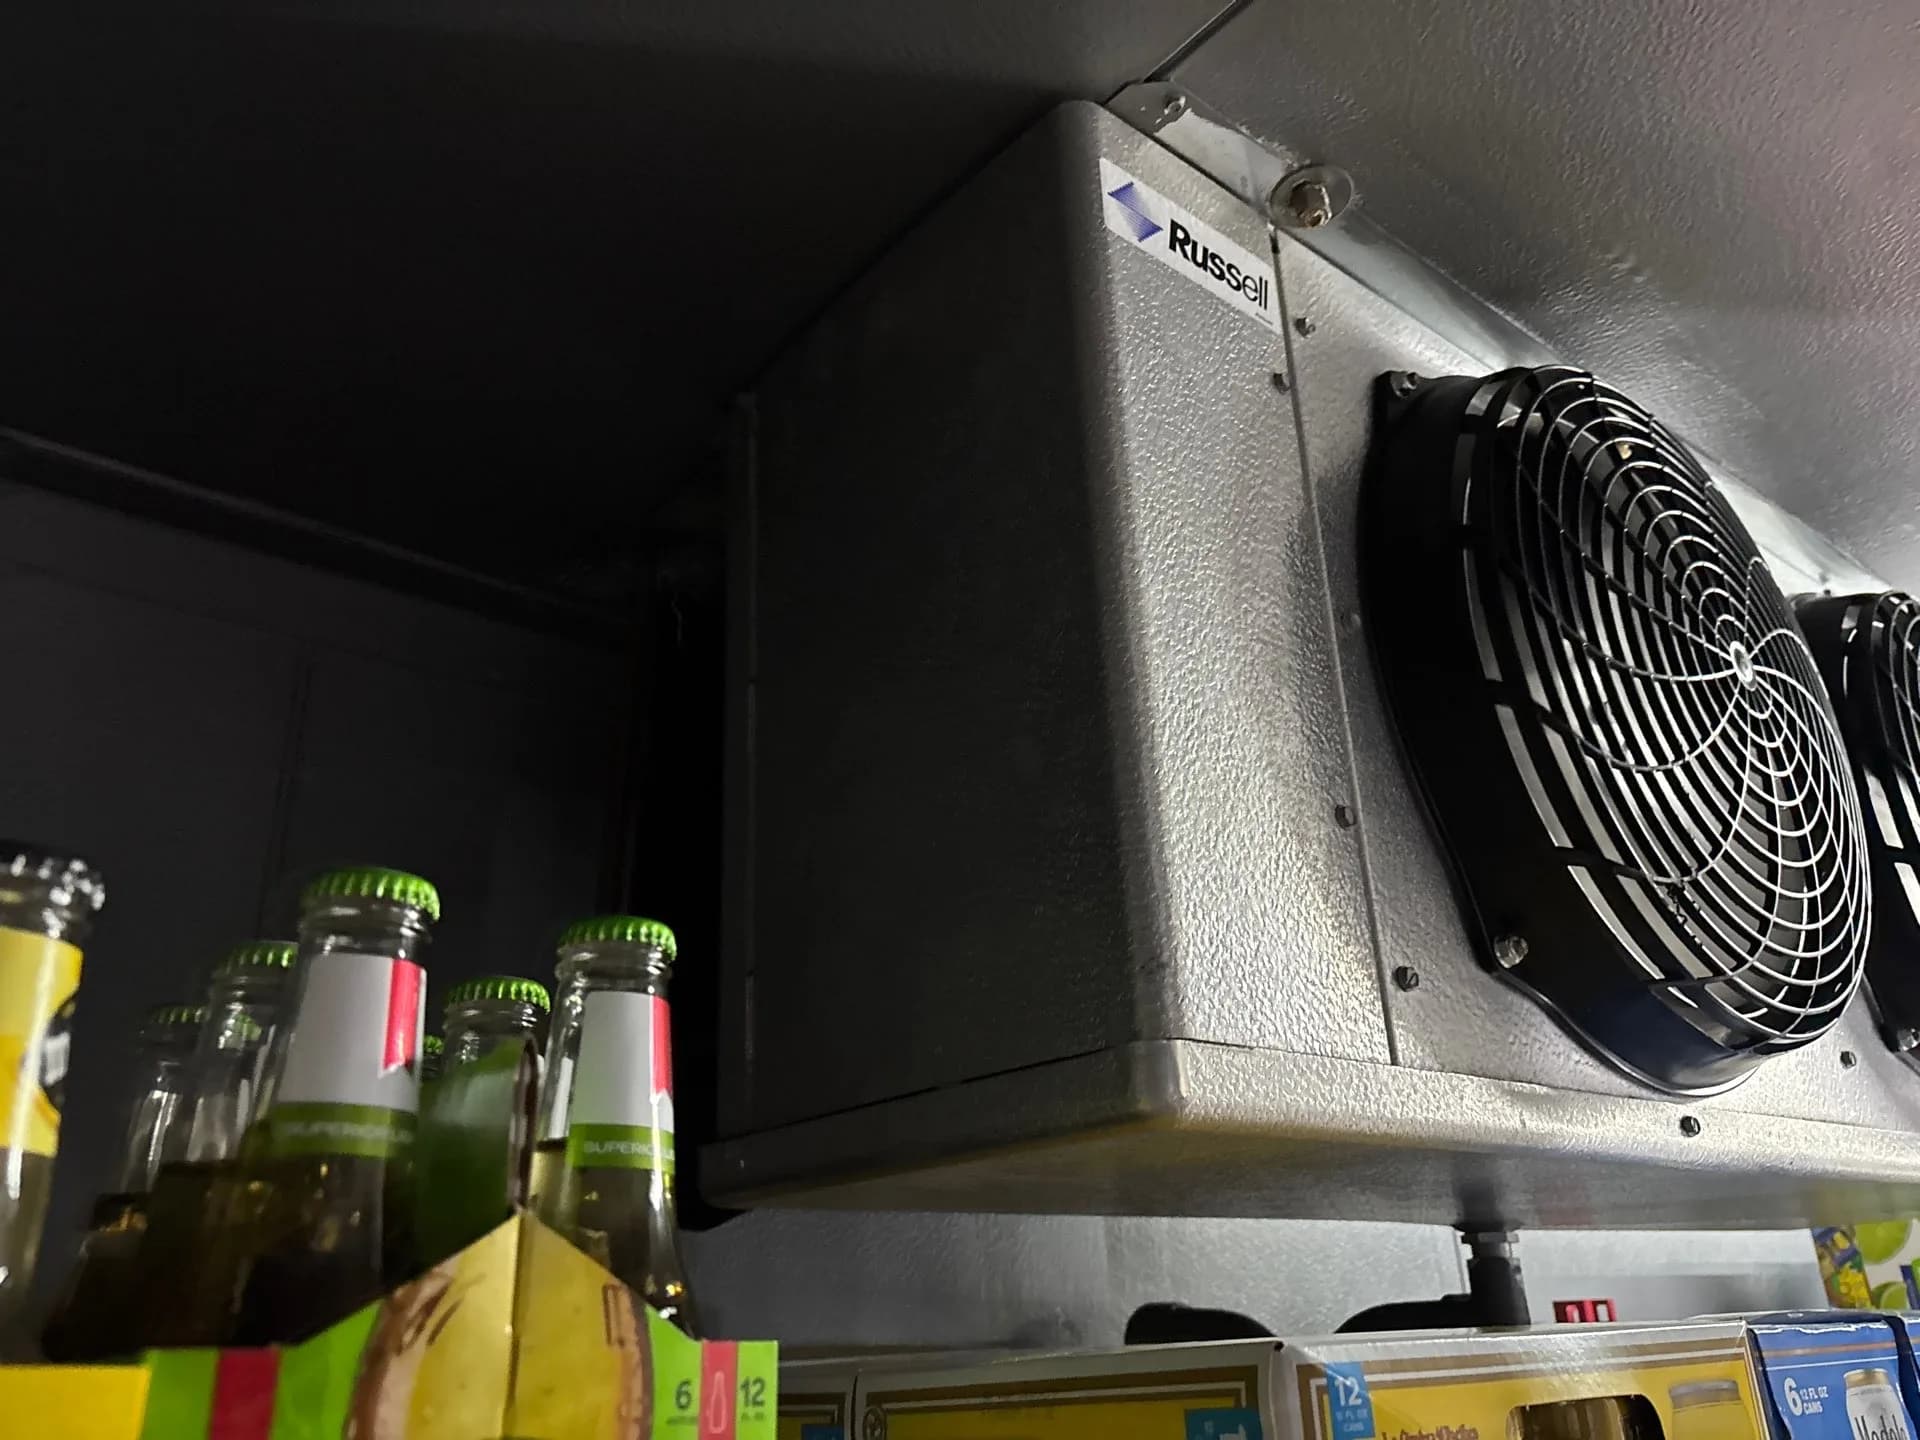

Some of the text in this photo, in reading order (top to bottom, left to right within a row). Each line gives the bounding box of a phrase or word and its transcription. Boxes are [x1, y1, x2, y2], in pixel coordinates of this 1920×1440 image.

[1168, 218, 1269, 311] Russell
[583, 1140, 659, 1158] SUPERIO
[675, 1379, 692, 1411] 6
[741, 1377, 766, 1408] 12
[1334, 1376, 1363, 1407] 12
[1784, 1377, 1802, 1416] 6
